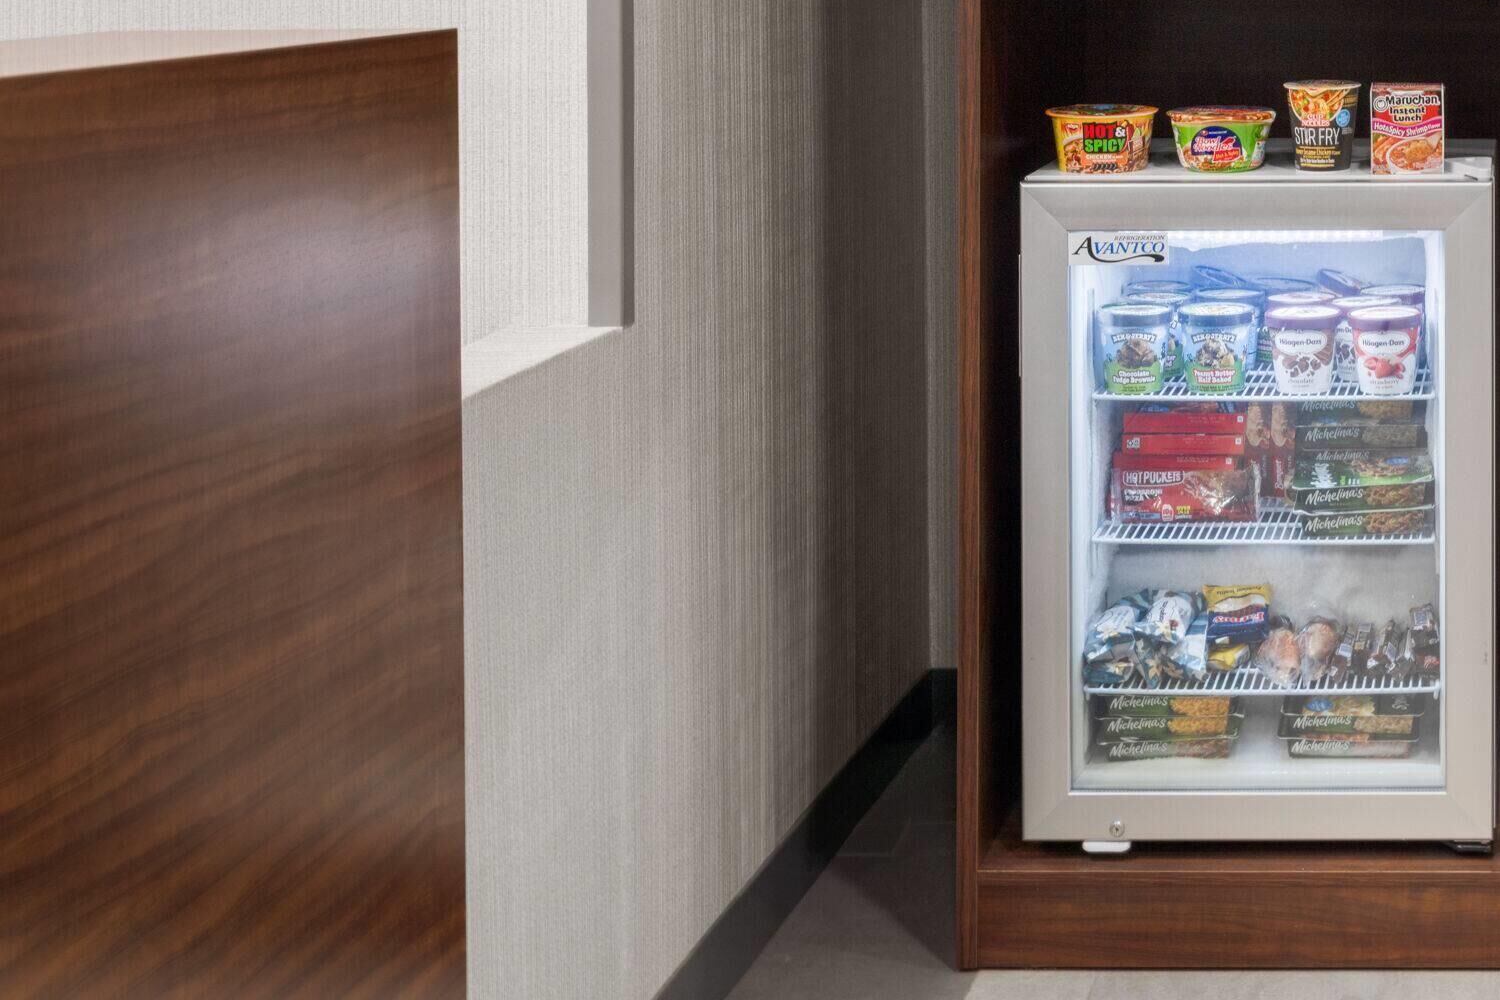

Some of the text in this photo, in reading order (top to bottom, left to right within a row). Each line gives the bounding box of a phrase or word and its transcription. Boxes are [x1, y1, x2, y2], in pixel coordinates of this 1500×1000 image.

[1386, 95, 1440, 105] Maruchan
[1302, 119, 1330, 127] NOODLES
[1084, 123, 1126, 139] HOT &
[1294, 127, 1340, 145] STIR FRY
[1406, 126, 1427, 137] Shrimp
[1084, 138, 1126, 153] SPICY
[1085, 153, 1113, 161] CHICKEN
[1072, 236, 1165, 258] AVANTCO
[1131, 375, 1156, 384] Brownie
[1305, 427, 1360, 442] Michelina's
[1126, 471, 1181, 484] HOT POCKETS
[1305, 488, 1364, 505] Michelina's
[1305, 515, 1363, 532] Michelina's
[1110, 695, 1169, 709] Michelina's
[1107, 717, 1166, 733] Michelina's
[1292, 713, 1351, 730] Michelina's
[1110, 740, 1168, 758] Michelina's
[1291, 738, 1350, 754] Michelina's
